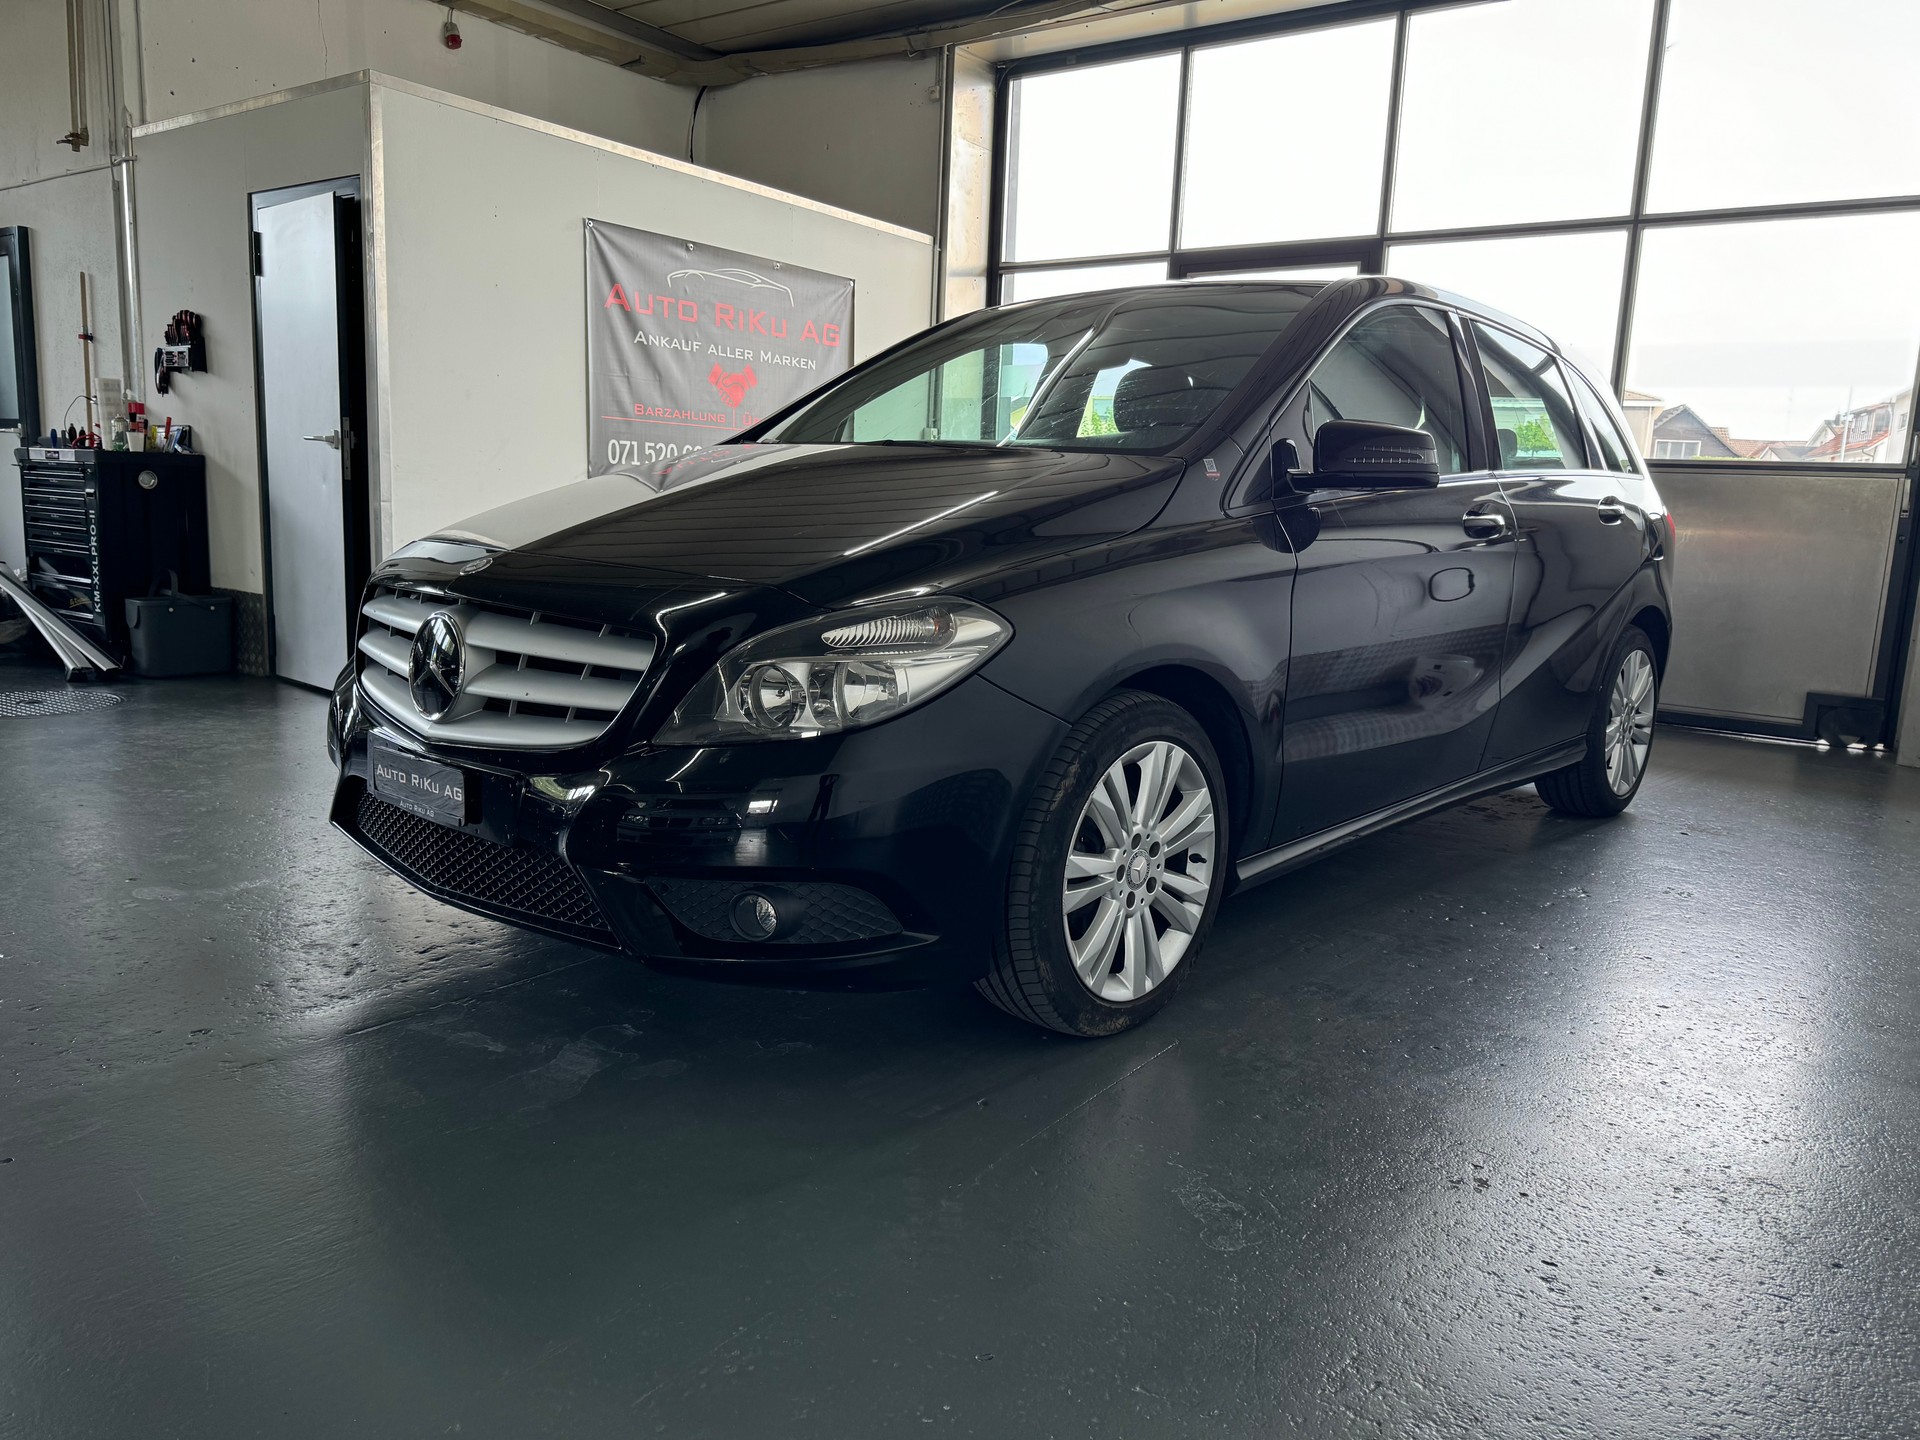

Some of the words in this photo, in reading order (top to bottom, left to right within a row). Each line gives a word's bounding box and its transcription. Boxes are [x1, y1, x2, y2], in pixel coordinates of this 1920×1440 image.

[800, 319, 840, 347] AG
[633, 330, 702, 353] ANKAUF
[707, 343, 754, 361] ALLER
[760, 349, 816, 370] MARKEN
[634, 403, 726, 424] BARZAHLUNG
[607, 439, 640, 466] 071
[444, 785, 462, 801] AG
